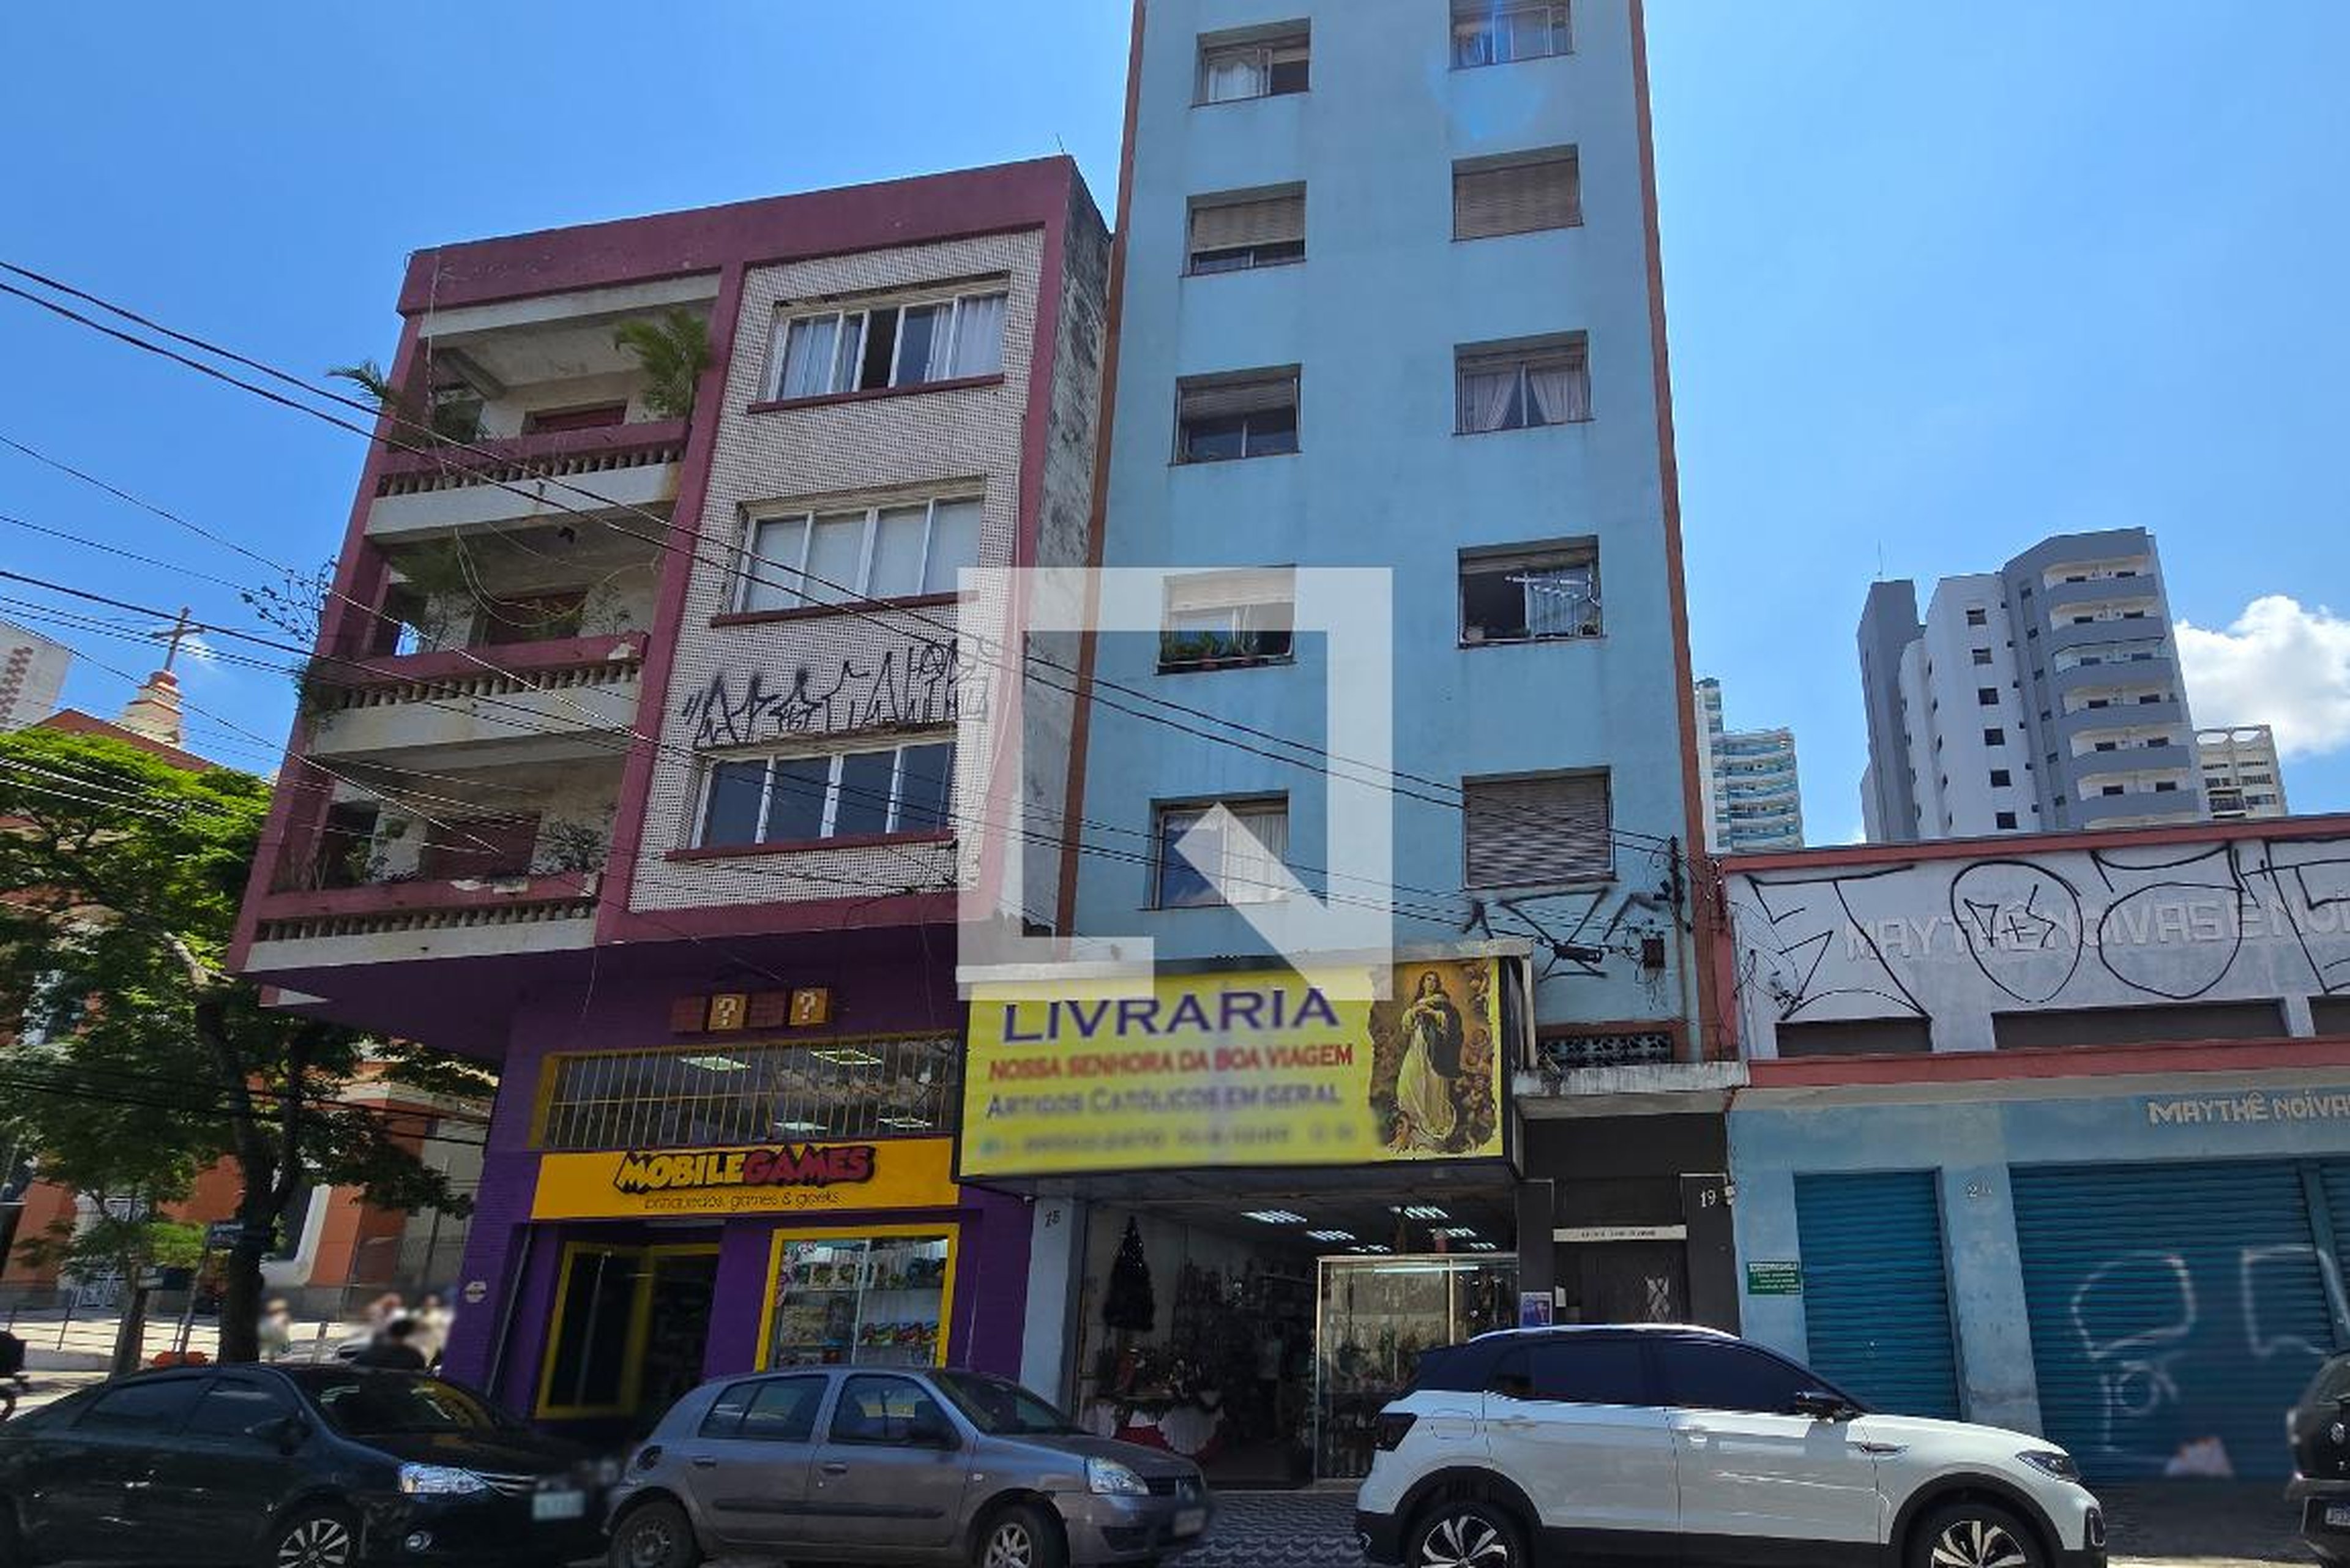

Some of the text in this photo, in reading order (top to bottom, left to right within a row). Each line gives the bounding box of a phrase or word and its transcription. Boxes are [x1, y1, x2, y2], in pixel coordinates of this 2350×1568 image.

[1004, 985, 1340, 1043] LIVRARIA
[988, 1043, 1353, 1081] NOSSA SENHORA DA BOA VIAGEM
